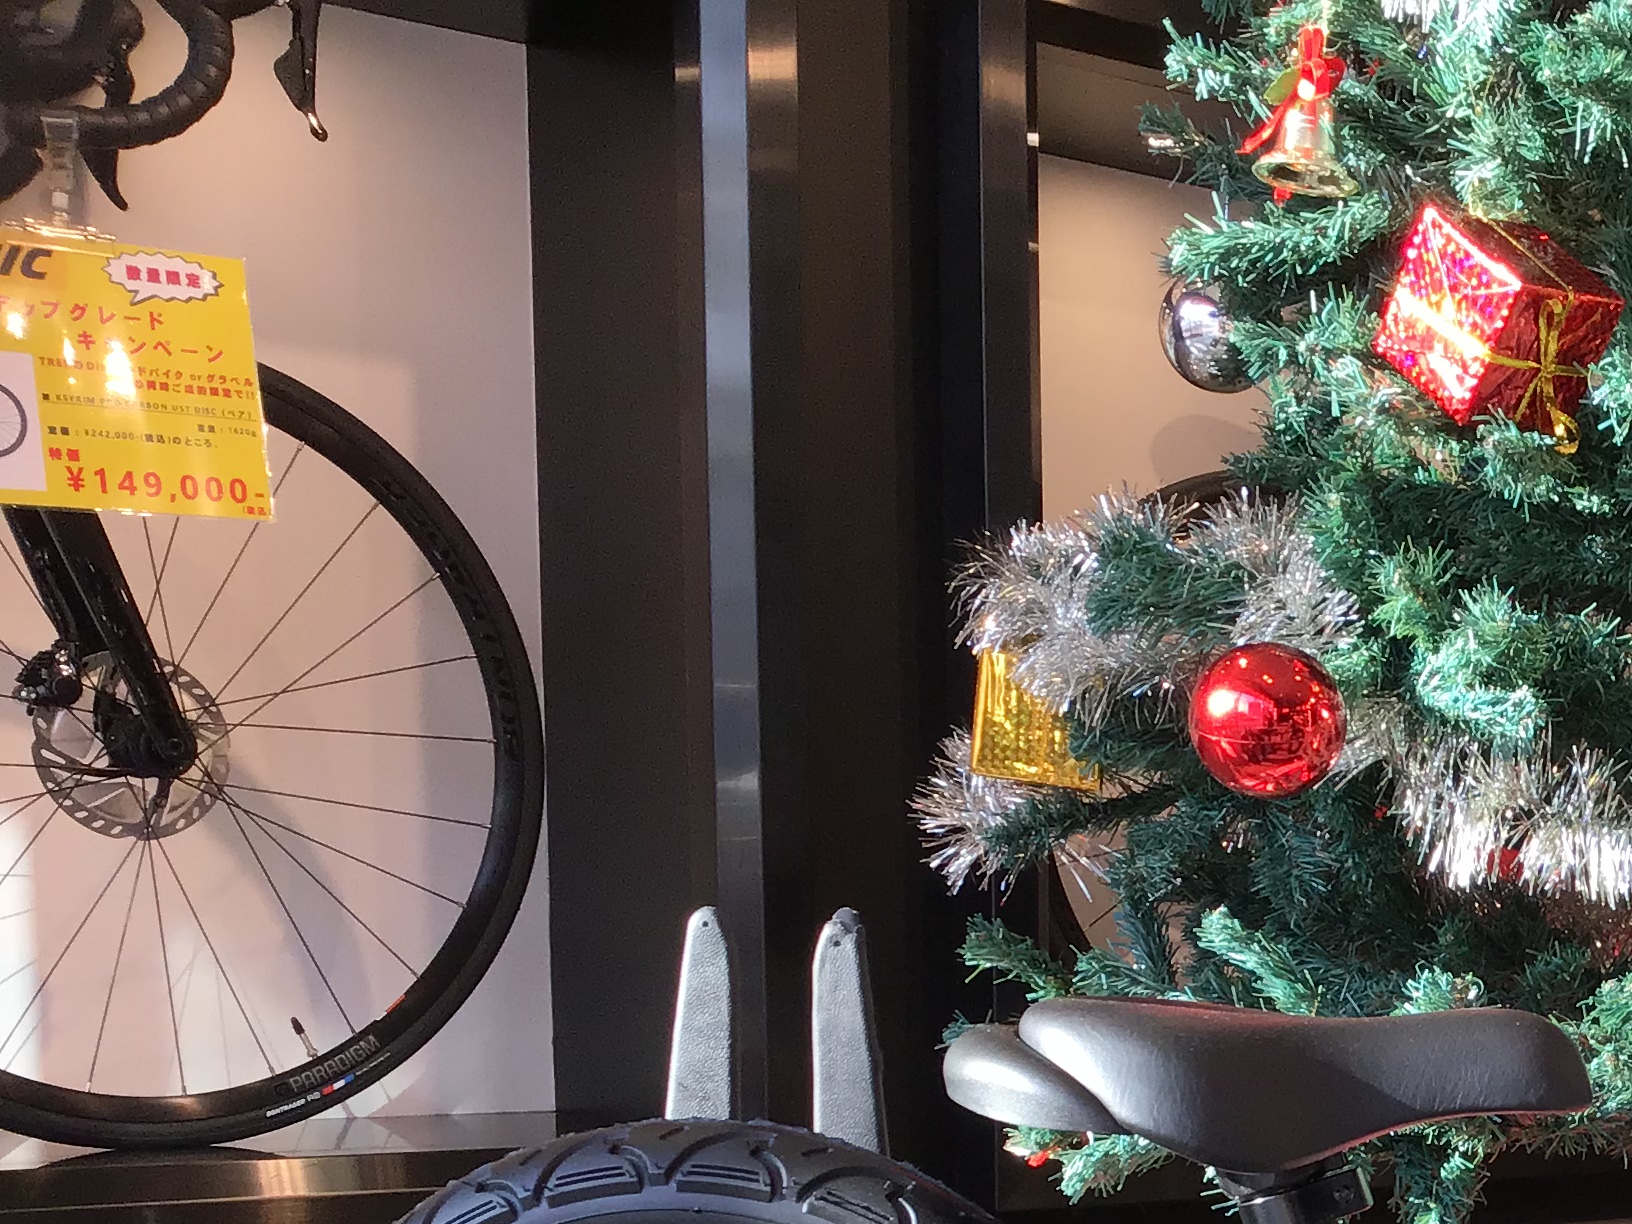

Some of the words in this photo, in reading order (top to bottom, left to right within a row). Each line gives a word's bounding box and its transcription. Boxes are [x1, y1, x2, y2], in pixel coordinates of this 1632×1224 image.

[0, 243, 53, 280] IC
[125, 263, 201, 290] 数量限定
[0, 295, 164, 331] ップグレード
[77, 330, 224, 364] キンペーン
[288, 1033, 382, 1093] PARADIGM
